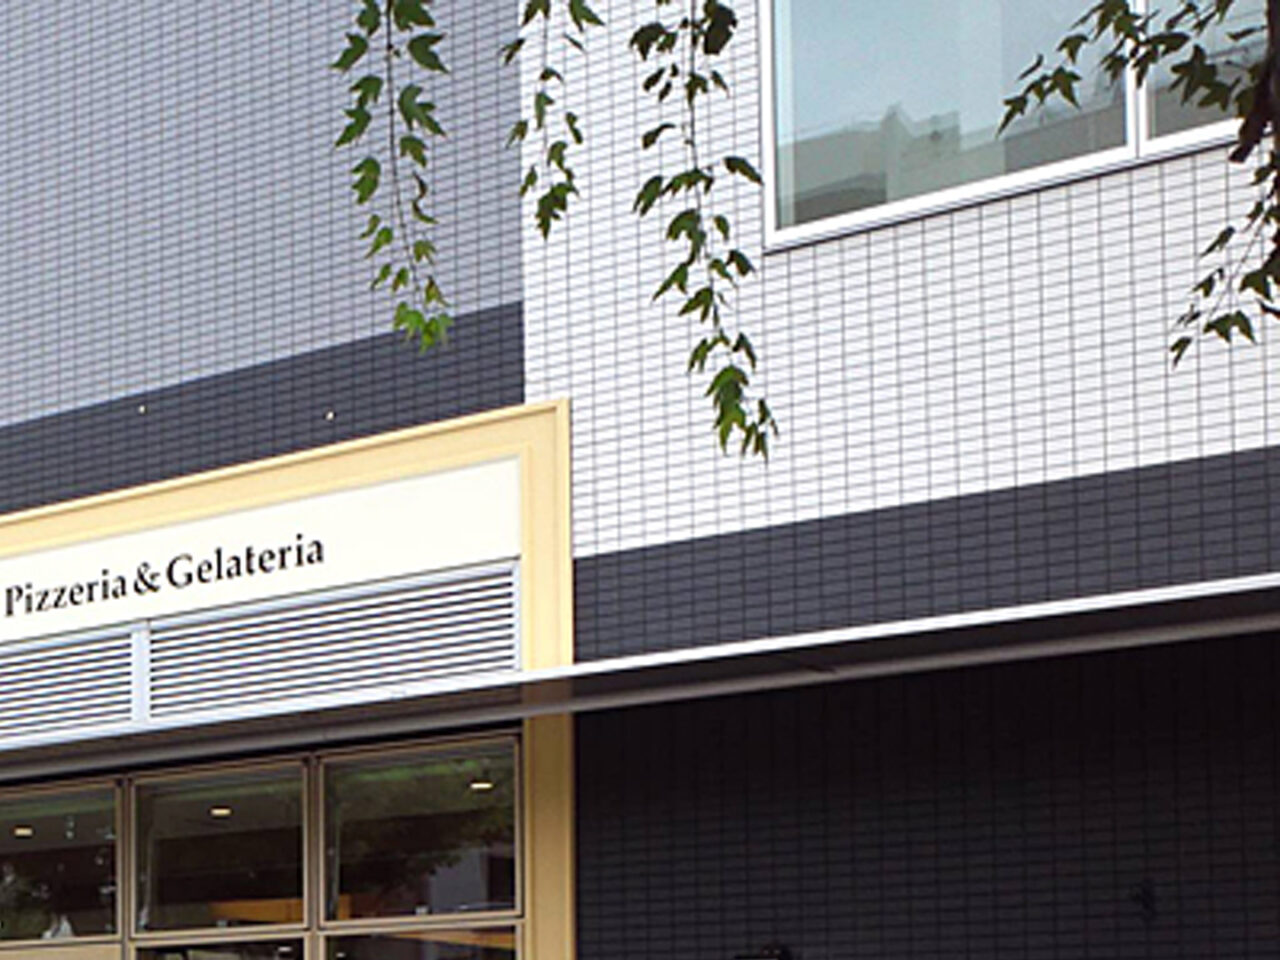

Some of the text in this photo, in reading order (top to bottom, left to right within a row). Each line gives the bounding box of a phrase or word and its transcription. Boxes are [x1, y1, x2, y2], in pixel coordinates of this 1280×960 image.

[5, 533, 324, 617] Pizzeria & Gelateria
